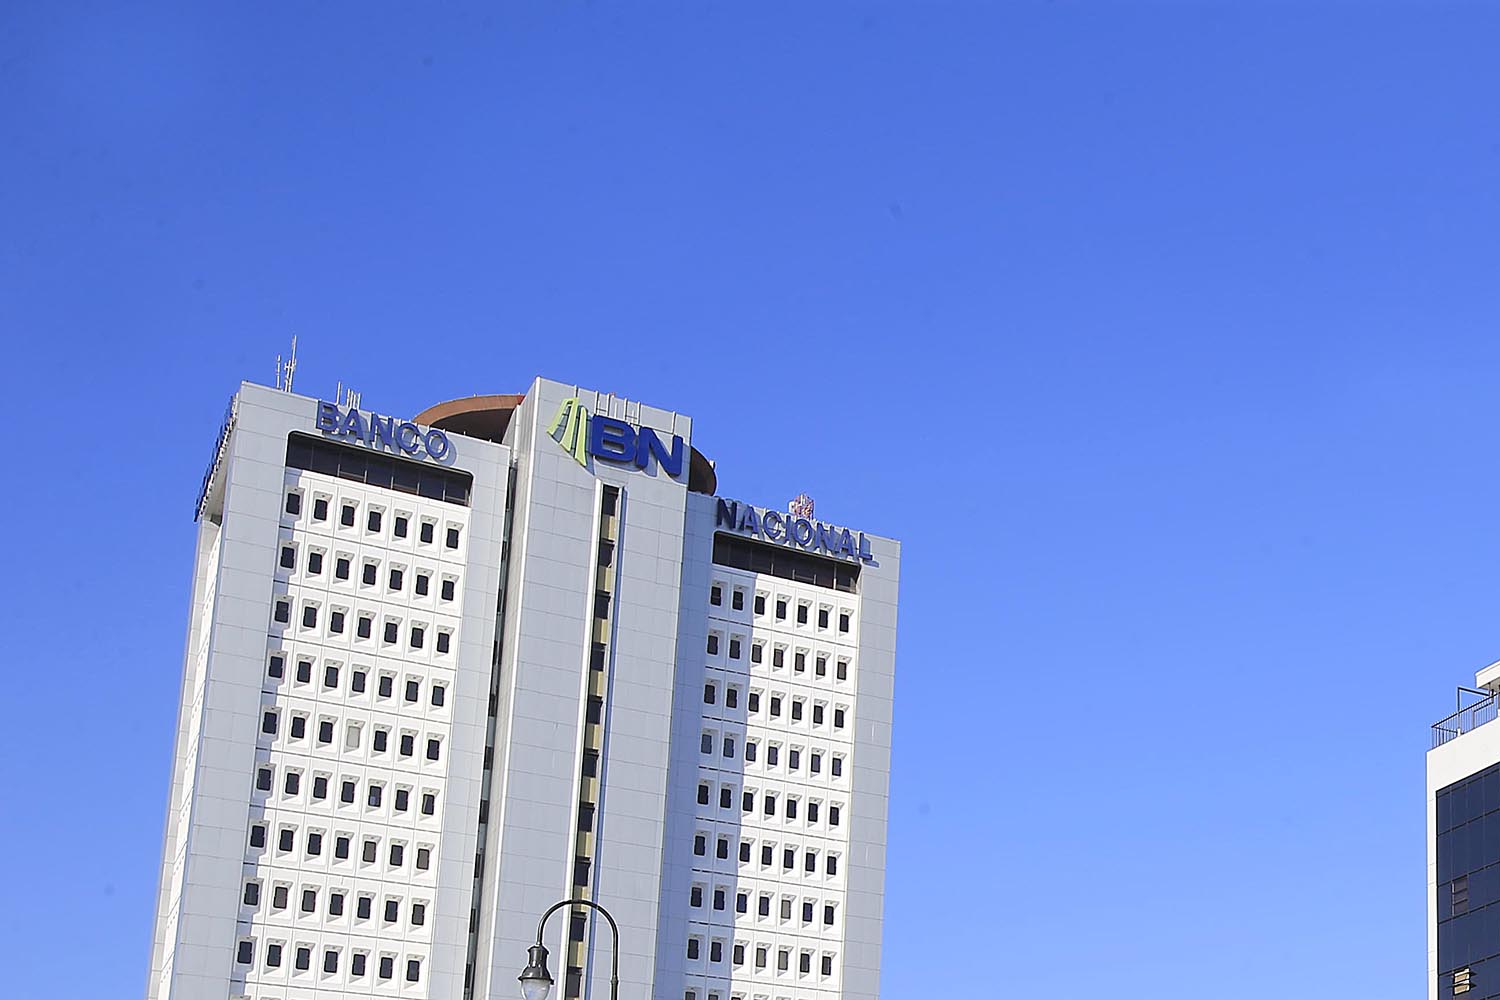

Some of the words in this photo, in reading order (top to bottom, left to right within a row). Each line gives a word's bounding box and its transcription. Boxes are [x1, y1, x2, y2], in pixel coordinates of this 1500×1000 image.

[315, 400, 449, 459] BANCO
[590, 414, 684, 477] BN
[717, 497, 874, 561] NACIONAL
